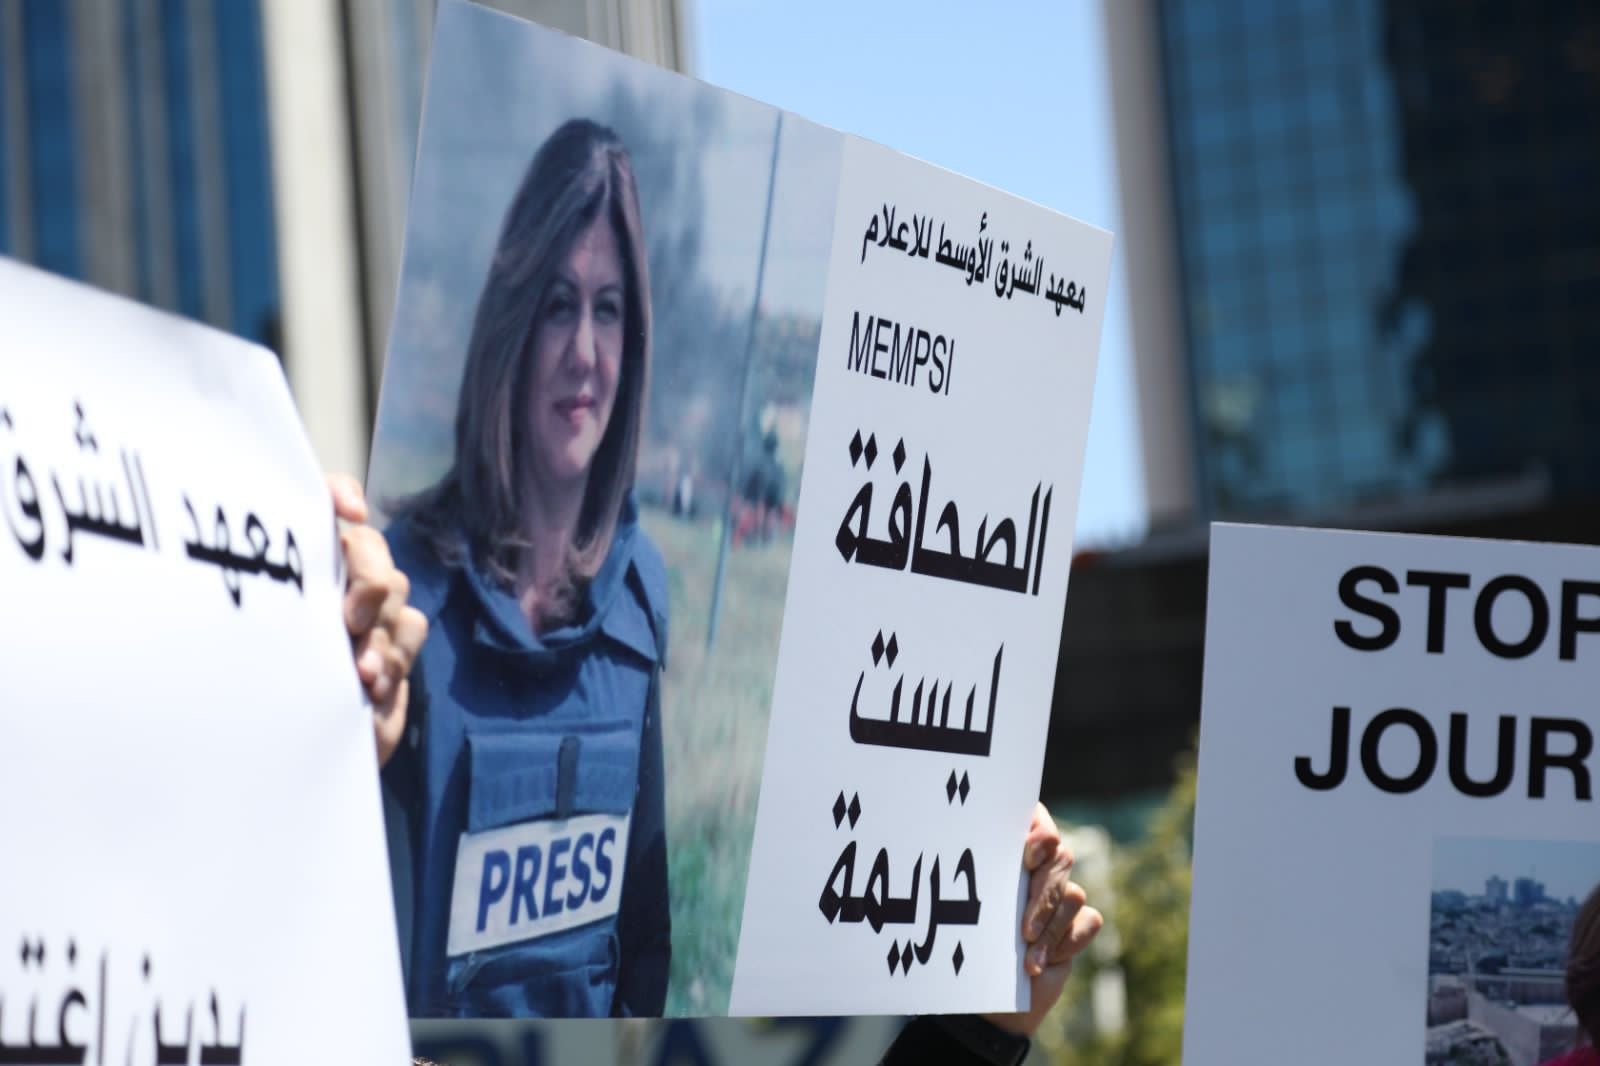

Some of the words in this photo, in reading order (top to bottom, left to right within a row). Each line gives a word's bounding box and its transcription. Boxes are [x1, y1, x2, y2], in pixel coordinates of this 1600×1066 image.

[861, 203, 934, 265] للاعلام
[935, 211, 994, 287] الأوسط
[994, 239, 1044, 300] الشرق
[1044, 272, 1086, 318] معهد
[847, 311, 955, 396] MEMPSI
[182, 492, 304, 609] معهد
[835, 428, 1053, 597] الصحافة
[848, 628, 1004, 806] ليست
[475, 827, 616, 933] PRESS
[818, 790, 982, 977] جريمة
